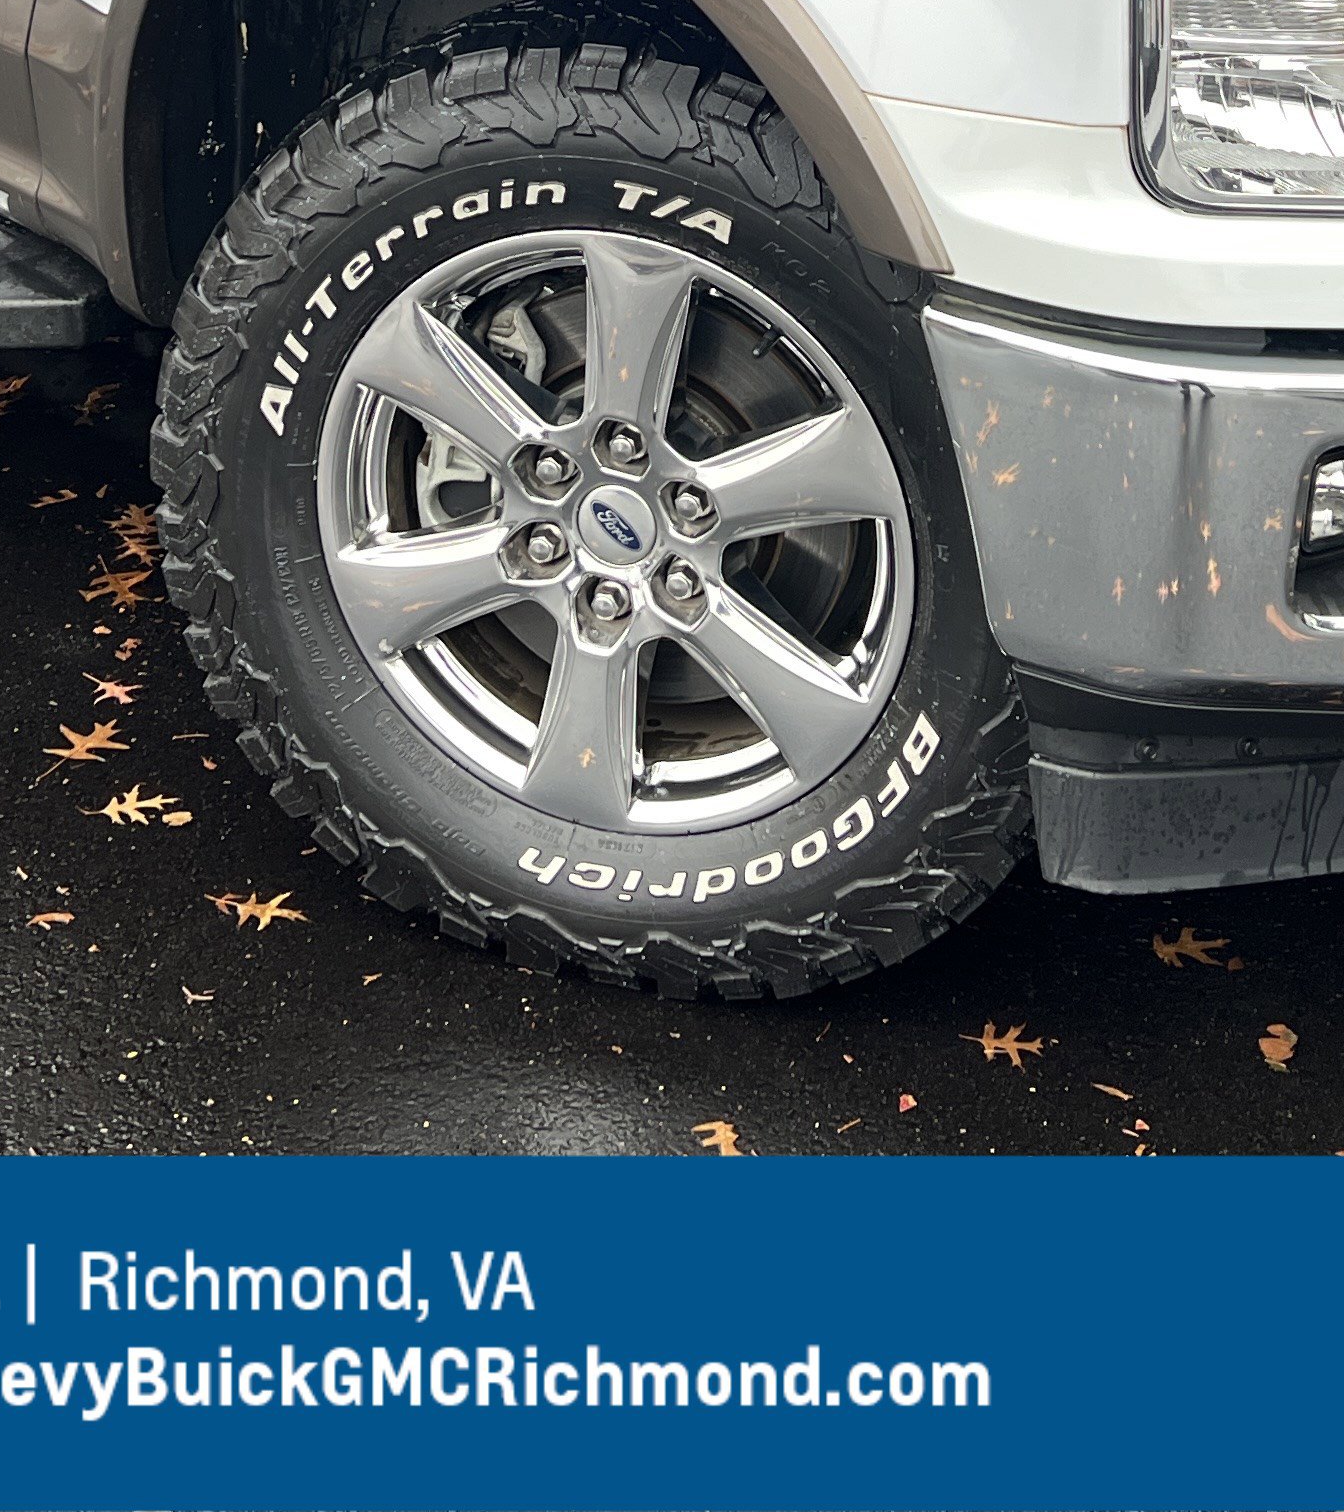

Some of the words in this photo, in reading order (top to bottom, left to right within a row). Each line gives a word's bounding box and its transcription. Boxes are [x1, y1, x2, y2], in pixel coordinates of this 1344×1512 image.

[250, 179, 567, 437] All-Terrain
[613, 180, 734, 246] T/A
[596, 509, 635, 545] Ford
[517, 710, 941, 904] BFGoodrich
